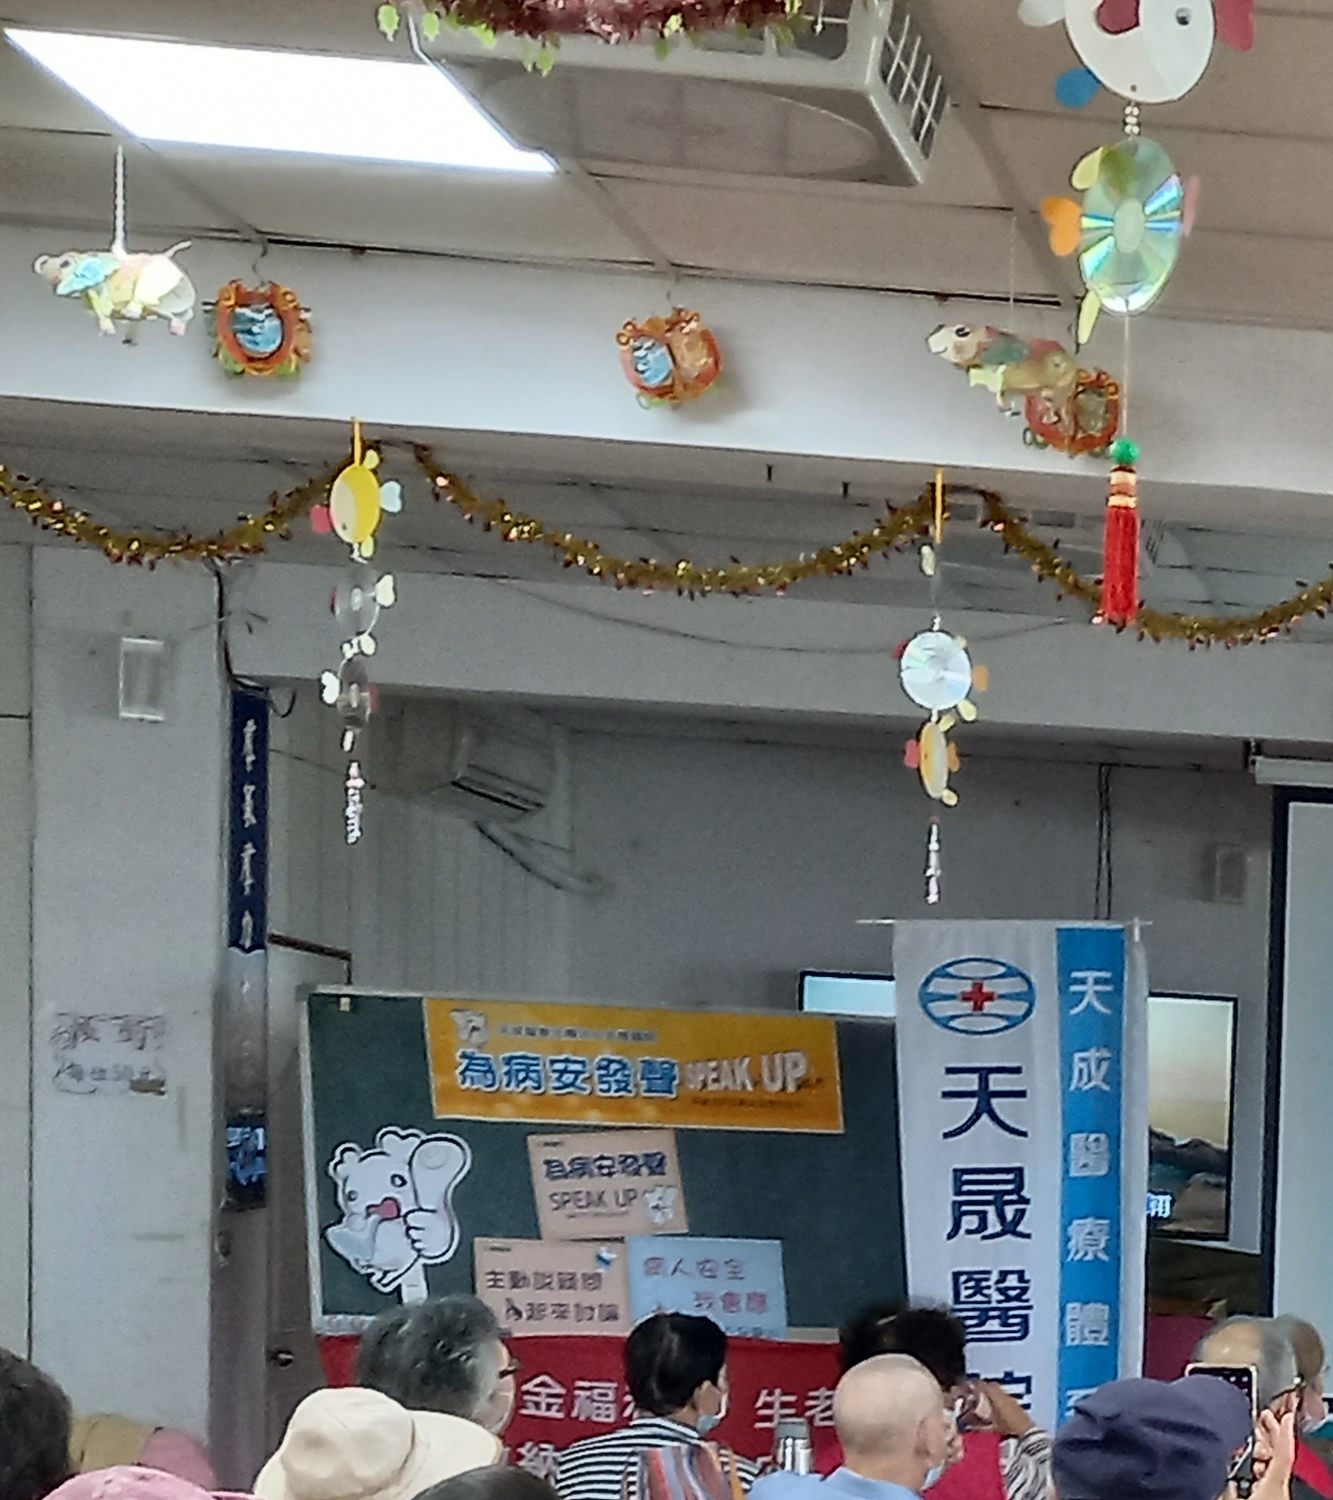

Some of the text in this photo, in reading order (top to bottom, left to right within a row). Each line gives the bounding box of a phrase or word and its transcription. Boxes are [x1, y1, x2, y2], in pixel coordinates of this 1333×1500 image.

[457, 1048, 807, 1099] 為病安發聲 SPEAK UP
[550, 1188, 638, 1211] SPEAK UP
[519, 1373, 641, 1424] 金福
